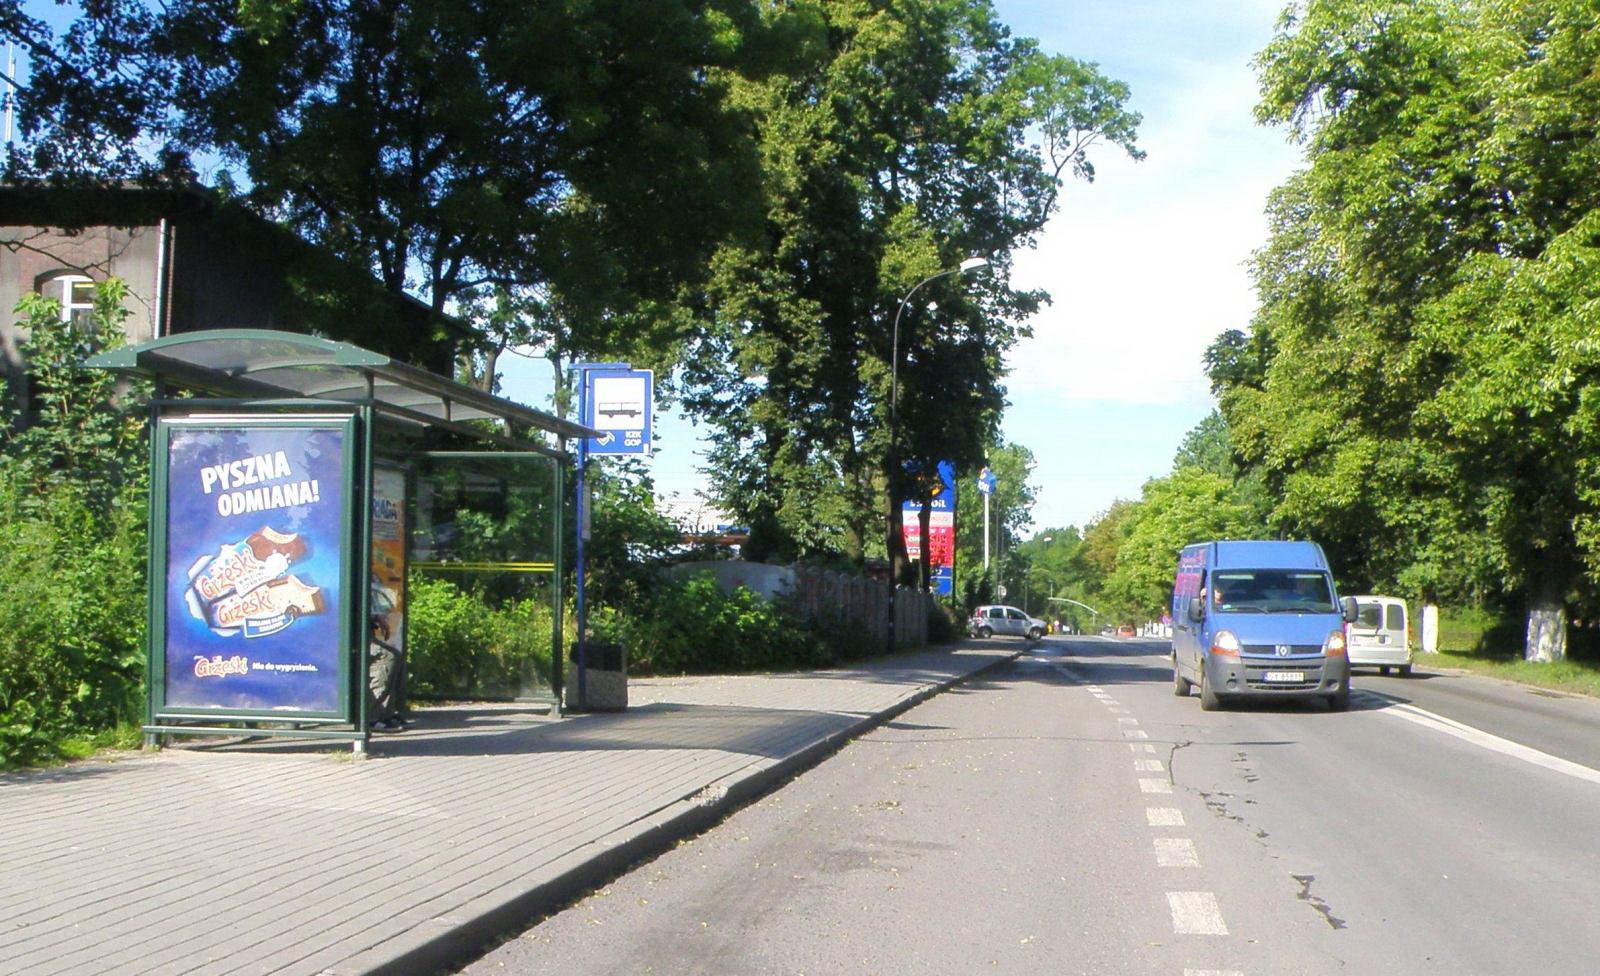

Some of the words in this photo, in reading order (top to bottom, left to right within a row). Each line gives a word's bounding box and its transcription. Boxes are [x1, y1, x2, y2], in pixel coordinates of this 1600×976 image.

[200, 450, 292, 494] PYSZNA
[218, 479, 320, 517] ODMIANA!
[252, 662, 265, 670] Nie
[265, 662, 275, 671] do
